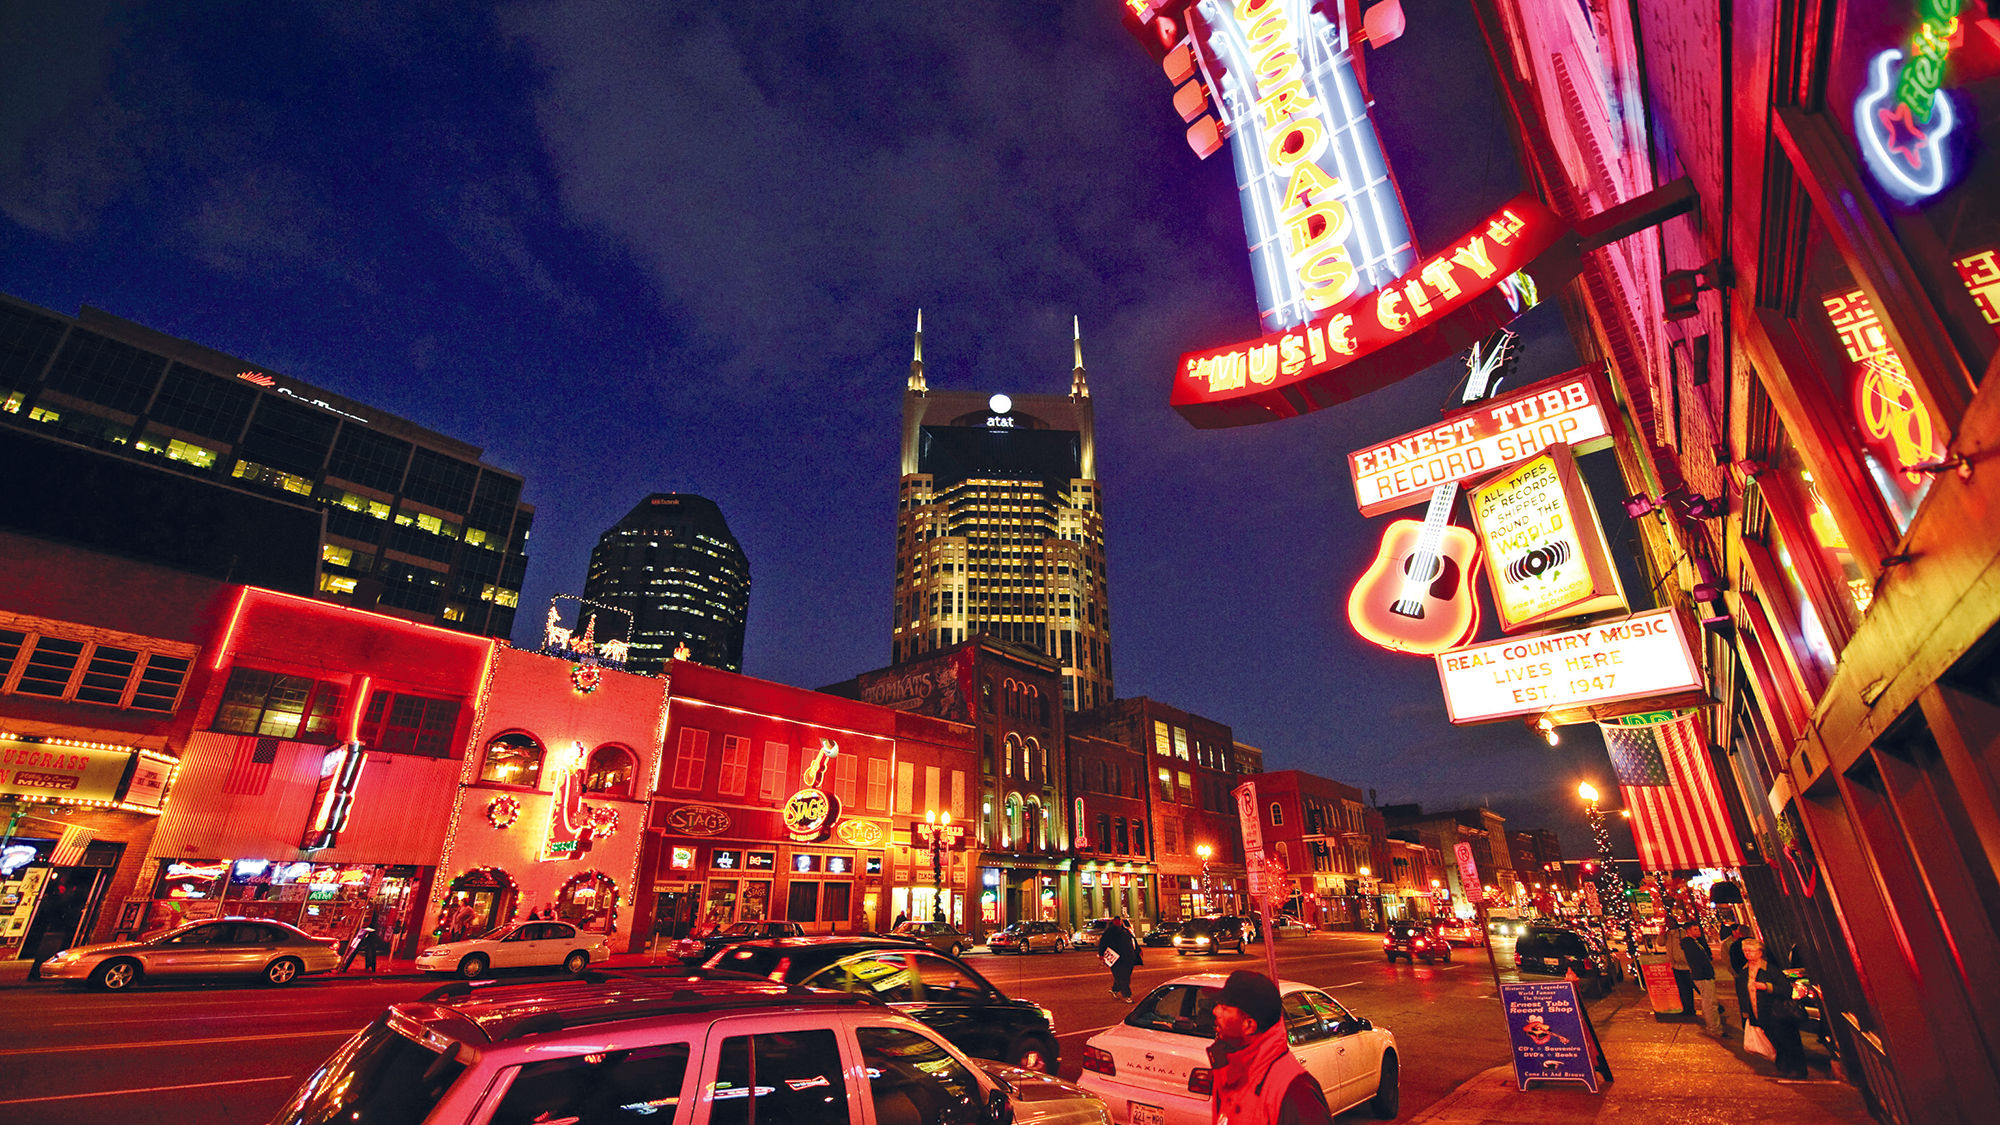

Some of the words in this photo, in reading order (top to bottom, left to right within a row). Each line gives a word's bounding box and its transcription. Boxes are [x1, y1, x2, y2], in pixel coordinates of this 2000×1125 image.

[1207, 312, 1357, 393] MUSIC
[1376, 236, 1497, 331] CITY
[986, 416, 1014, 428] at&t
[1354, 417, 1475, 474] ERNEST
[1491, 382, 1589, 432] TUBB
[1376, 446, 1485, 498] RECORD
[1497, 417, 1578, 461] SHOP
[1481, 504, 1496, 518] OF
[1501, 472, 1557, 507] RECORDS
[1484, 489, 1504, 504] ALL
[1509, 463, 1547, 489] TYPES
[1490, 515, 1530, 540] ROUND
[1537, 499, 1560, 517] THE
[1498, 492, 1546, 524] SHIPPED
[1497, 513, 1563, 555] WORLD
[1446, 652, 1496, 672] REAL
[1503, 632, 1591, 661] COUNTRY
[1600, 619, 1668, 643] MUSIC
[1493, 662, 1552, 684] LIVES
[1565, 650, 1623, 672] HERE
[1512, 685, 1557, 703] EST.
[1569, 674, 1616, 695] 1947
[17, 779, 73, 790] MUSIC
[670, 807, 727, 829] STAGE
[785, 797, 826, 825] STAGE
[840, 822, 881, 840] STAGE
[309, 891, 333, 900] ATM
[1548, 1006, 1573, 1014] Shop
[1126, 1061, 1175, 1075] MAXIMA
